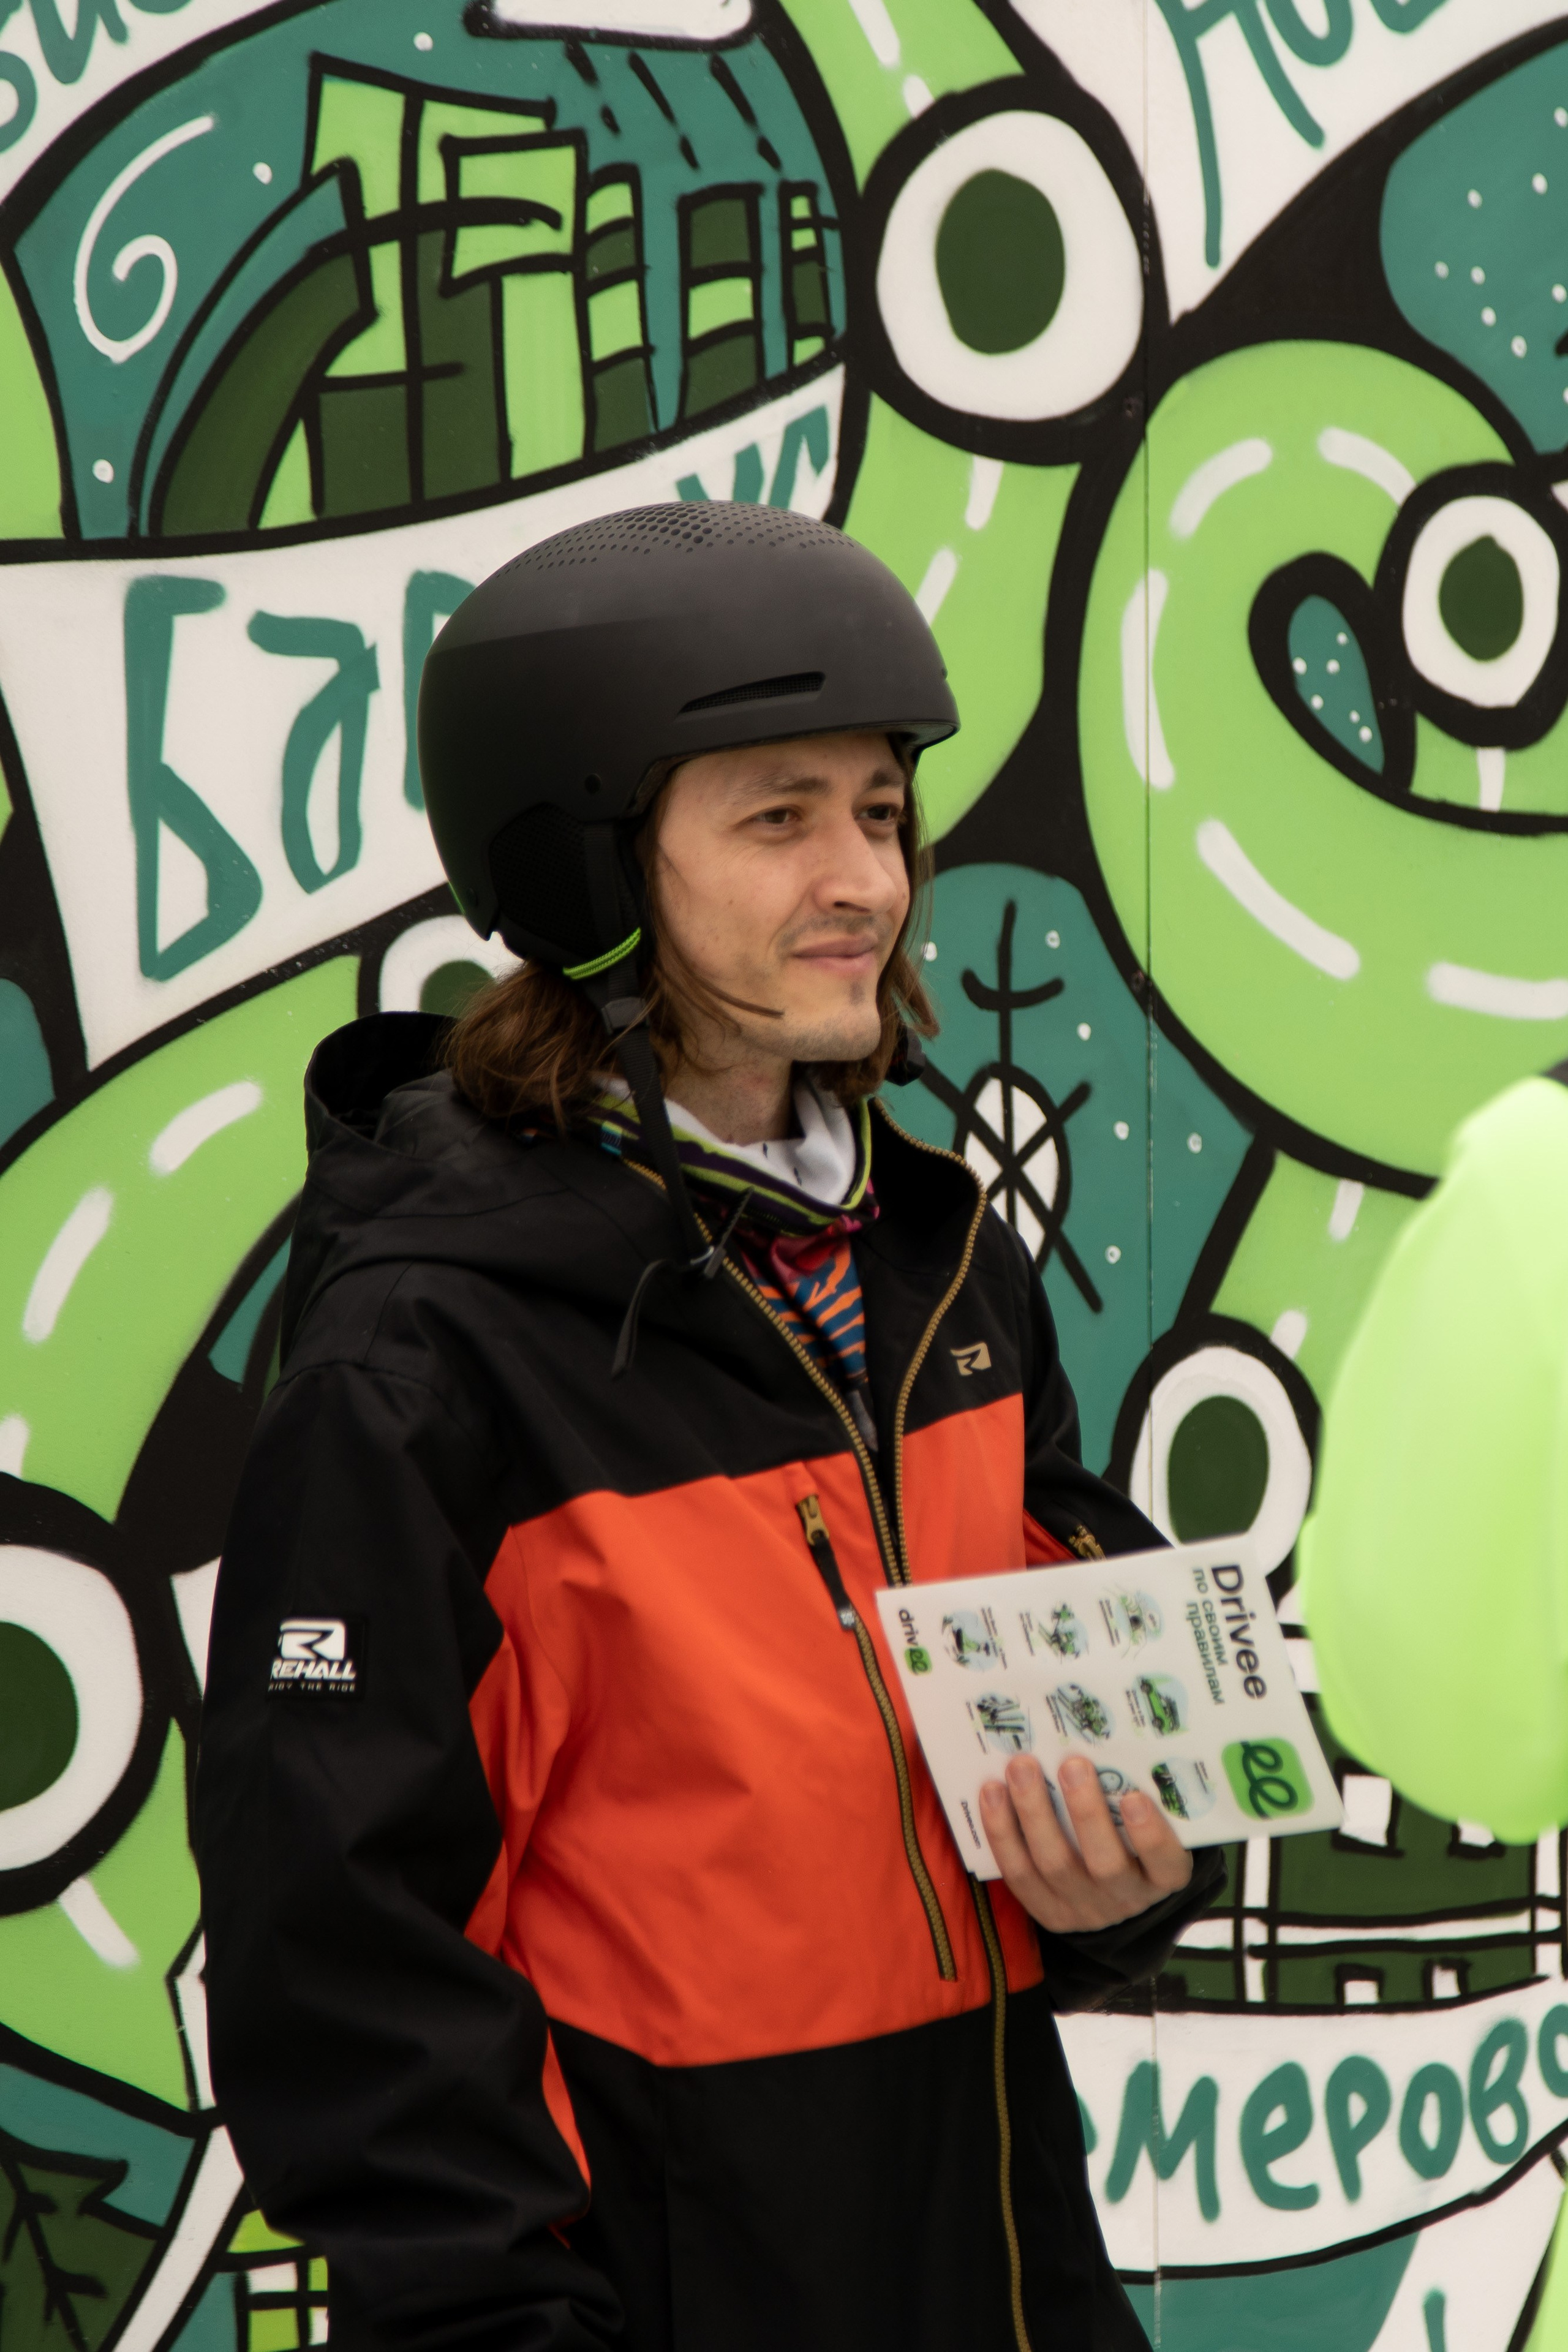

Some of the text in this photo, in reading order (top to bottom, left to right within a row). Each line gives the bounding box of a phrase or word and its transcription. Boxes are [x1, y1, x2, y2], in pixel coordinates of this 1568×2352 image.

[270, 1657, 356, 1681] REHALL
[1186, 1600, 1226, 1705] правилам
[1193, 1568, 1229, 1665] по своим
[1211, 1564, 1267, 1700] Drivee
[1076, 2003, 1568, 2223] мерово
